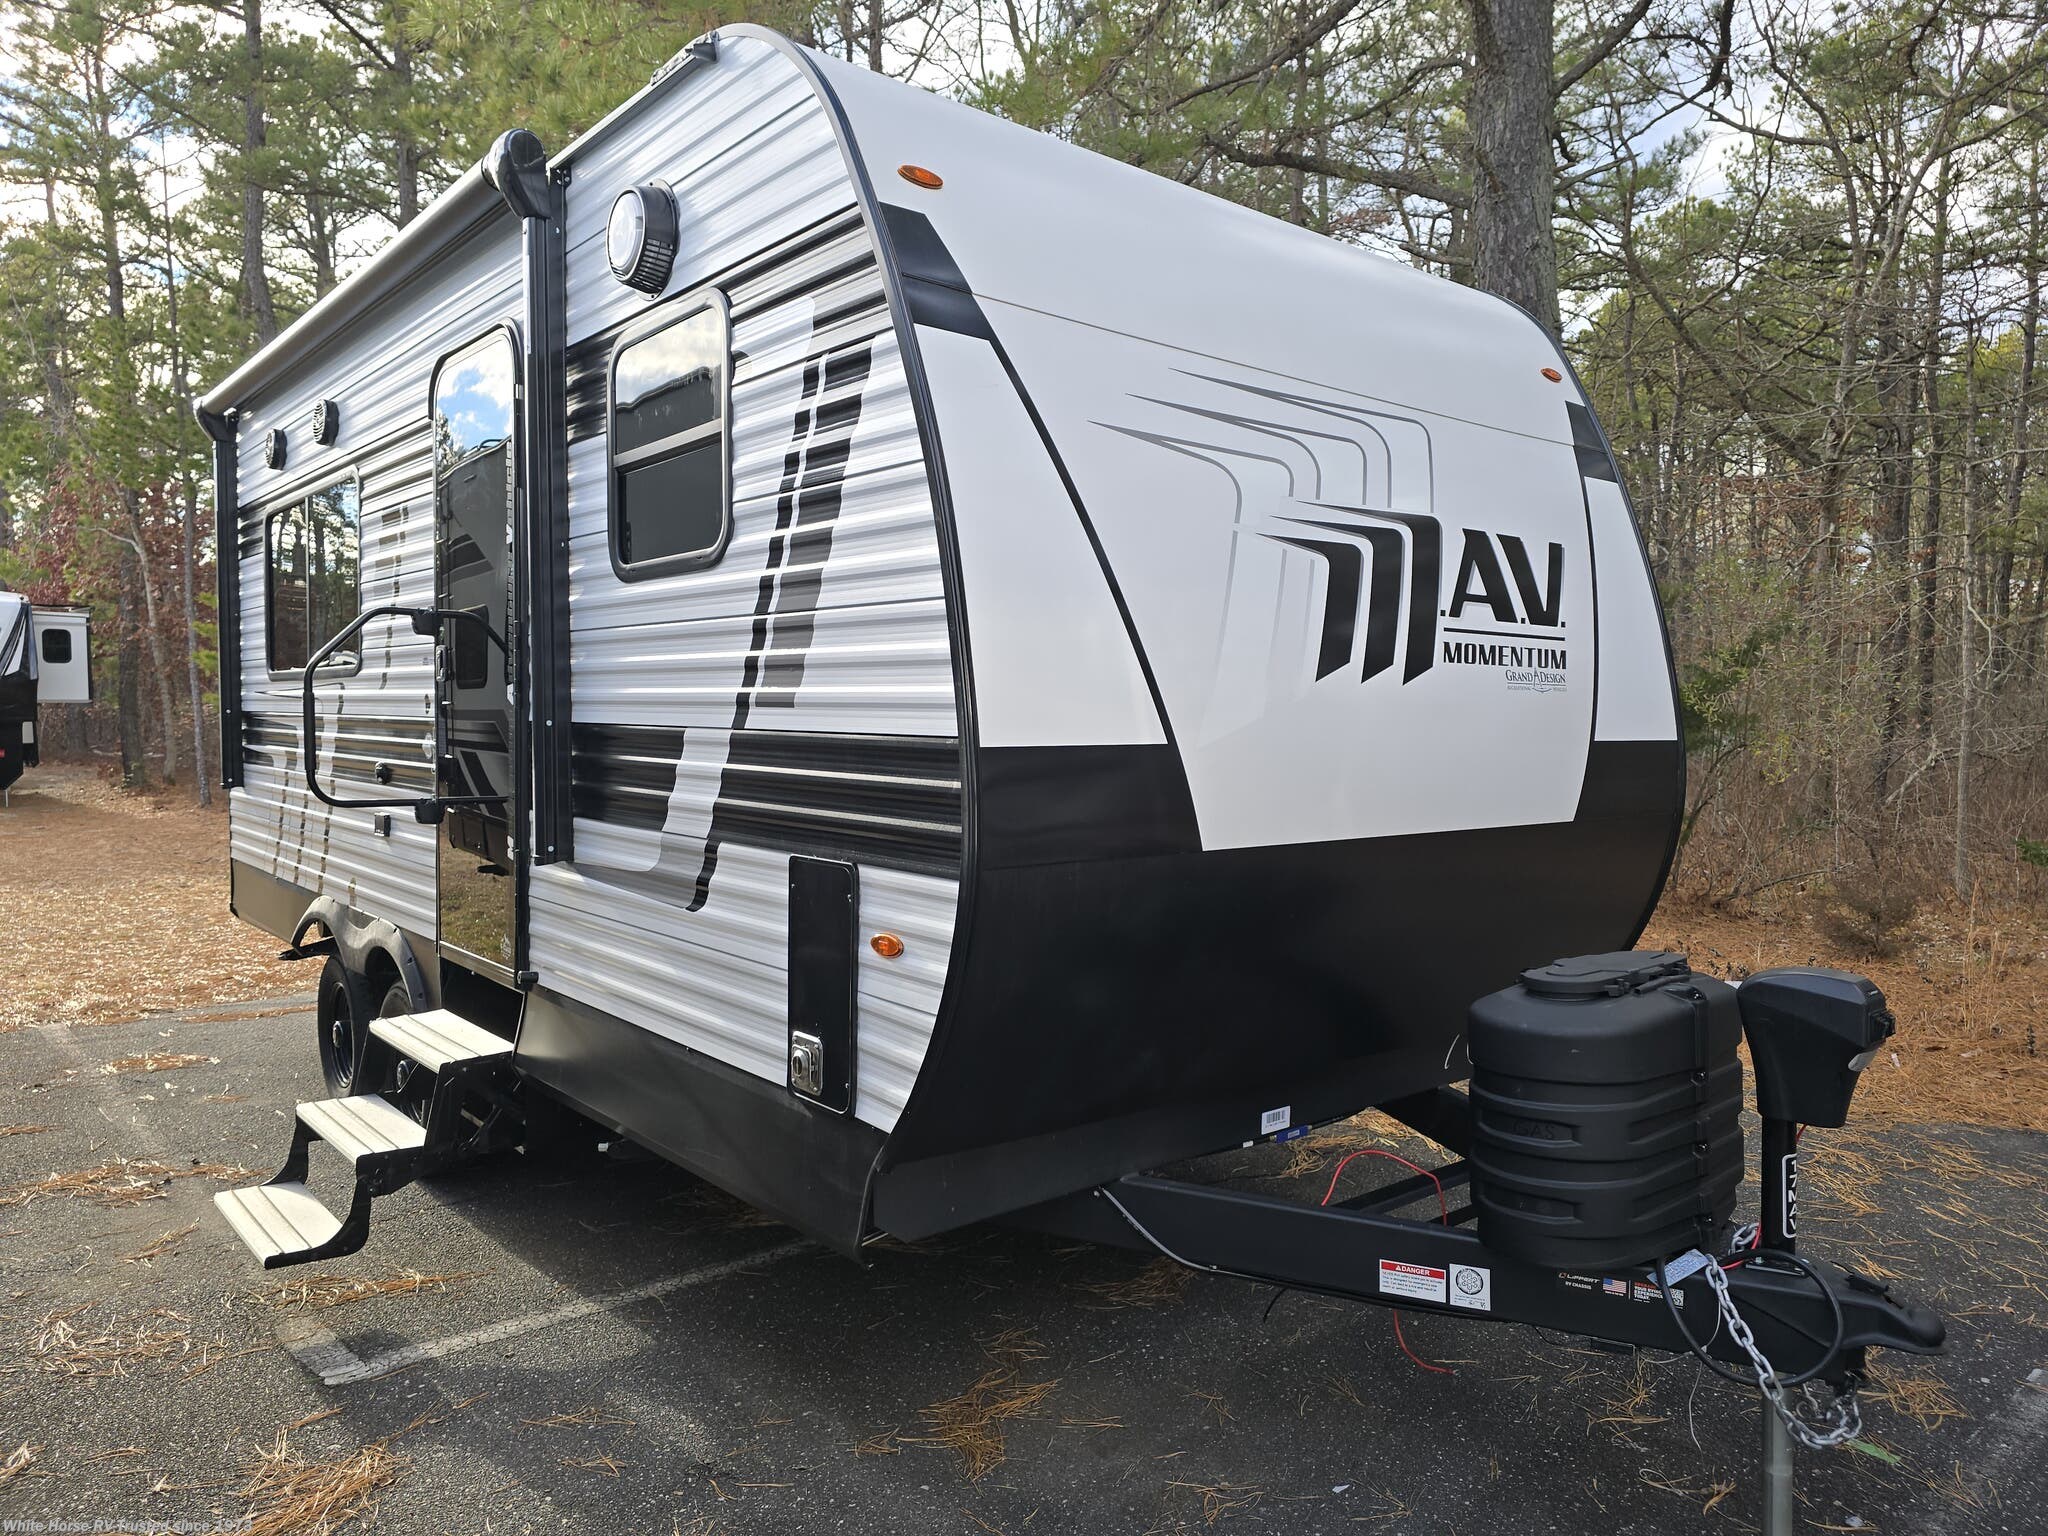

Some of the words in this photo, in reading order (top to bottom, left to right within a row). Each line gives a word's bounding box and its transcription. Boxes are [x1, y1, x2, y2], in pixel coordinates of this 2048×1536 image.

[1443, 641, 1567, 670] MOMENTUM
[1505, 669, 1533, 682] GRAND
[1540, 671, 1566, 684] DESIGN
[1401, 1265, 1431, 1276] DANGER
